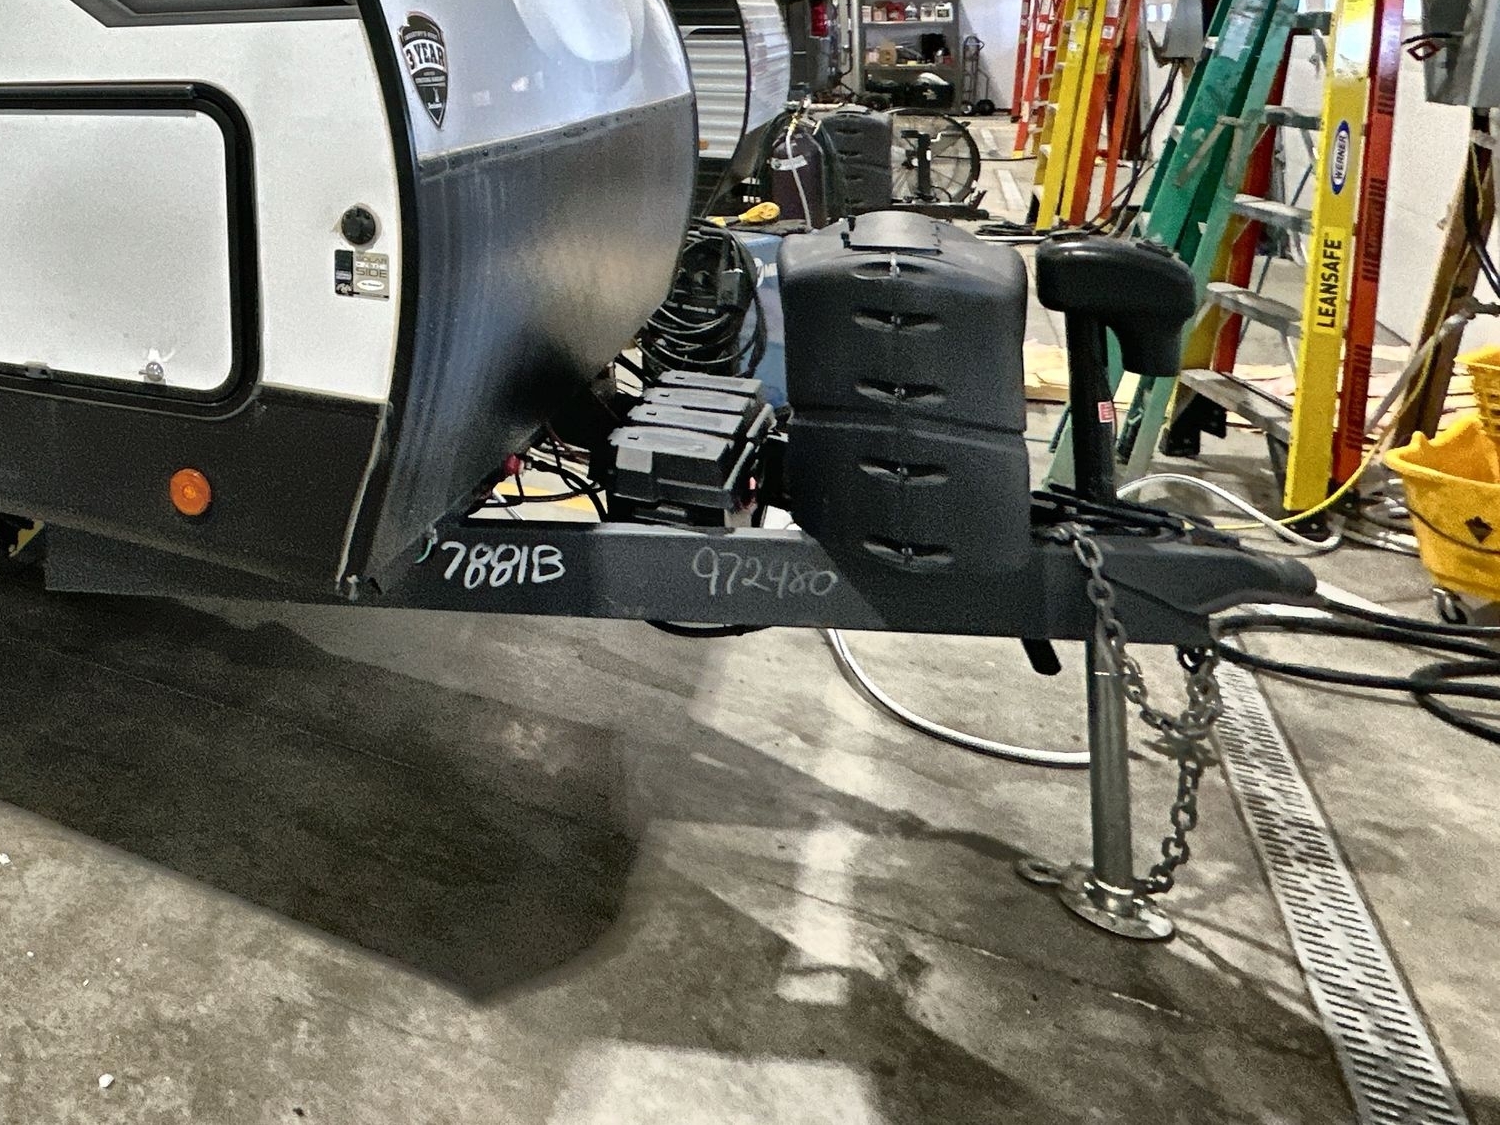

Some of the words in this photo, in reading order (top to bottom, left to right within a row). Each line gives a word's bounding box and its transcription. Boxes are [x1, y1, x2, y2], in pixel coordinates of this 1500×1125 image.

[405, 48, 415, 70] 3
[413, 42, 445, 67] YEAR
[1334, 134, 1347, 180] WERNER
[355, 267, 387, 278] SIDE
[1316, 237, 1343, 329] LEANSAFE
[690, 545, 839, 599] 972480
